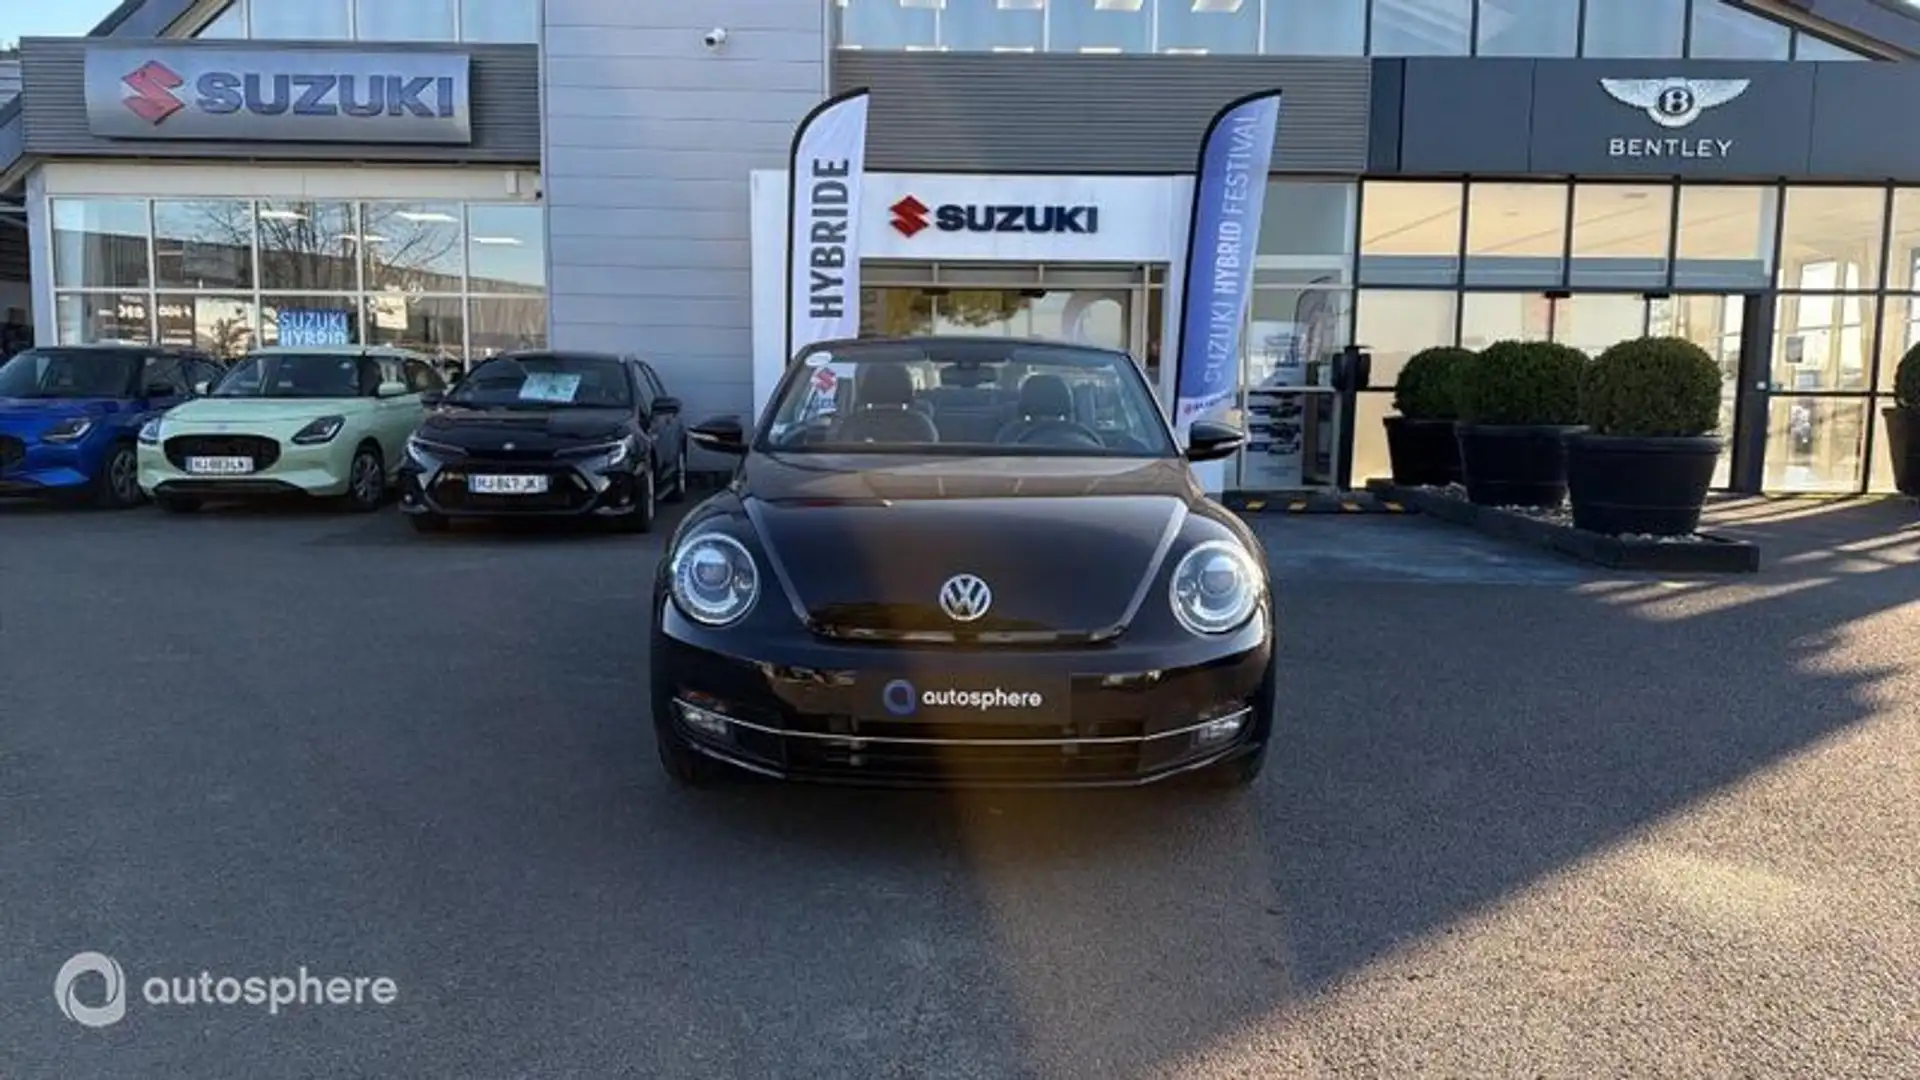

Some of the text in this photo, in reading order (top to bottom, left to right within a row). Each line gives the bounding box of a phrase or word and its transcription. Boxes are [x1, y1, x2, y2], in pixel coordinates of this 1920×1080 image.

[196, 72, 455, 118] SUZUKI
[1664, 87, 1689, 114] B
[1222, 112, 1260, 215] FESTIVAL
[1609, 138, 1733, 158] BENTLEY
[809, 158, 849, 318] HYBRIDE
[935, 204, 1098, 233] SUZUKI
[1213, 220, 1242, 294] HYBRID
[280, 311, 347, 329] SUZUKI
[1203, 301, 1237, 384] SUZUKI
[940, 574, 991, 620] VW
[922, 687, 1042, 711] autosphere
